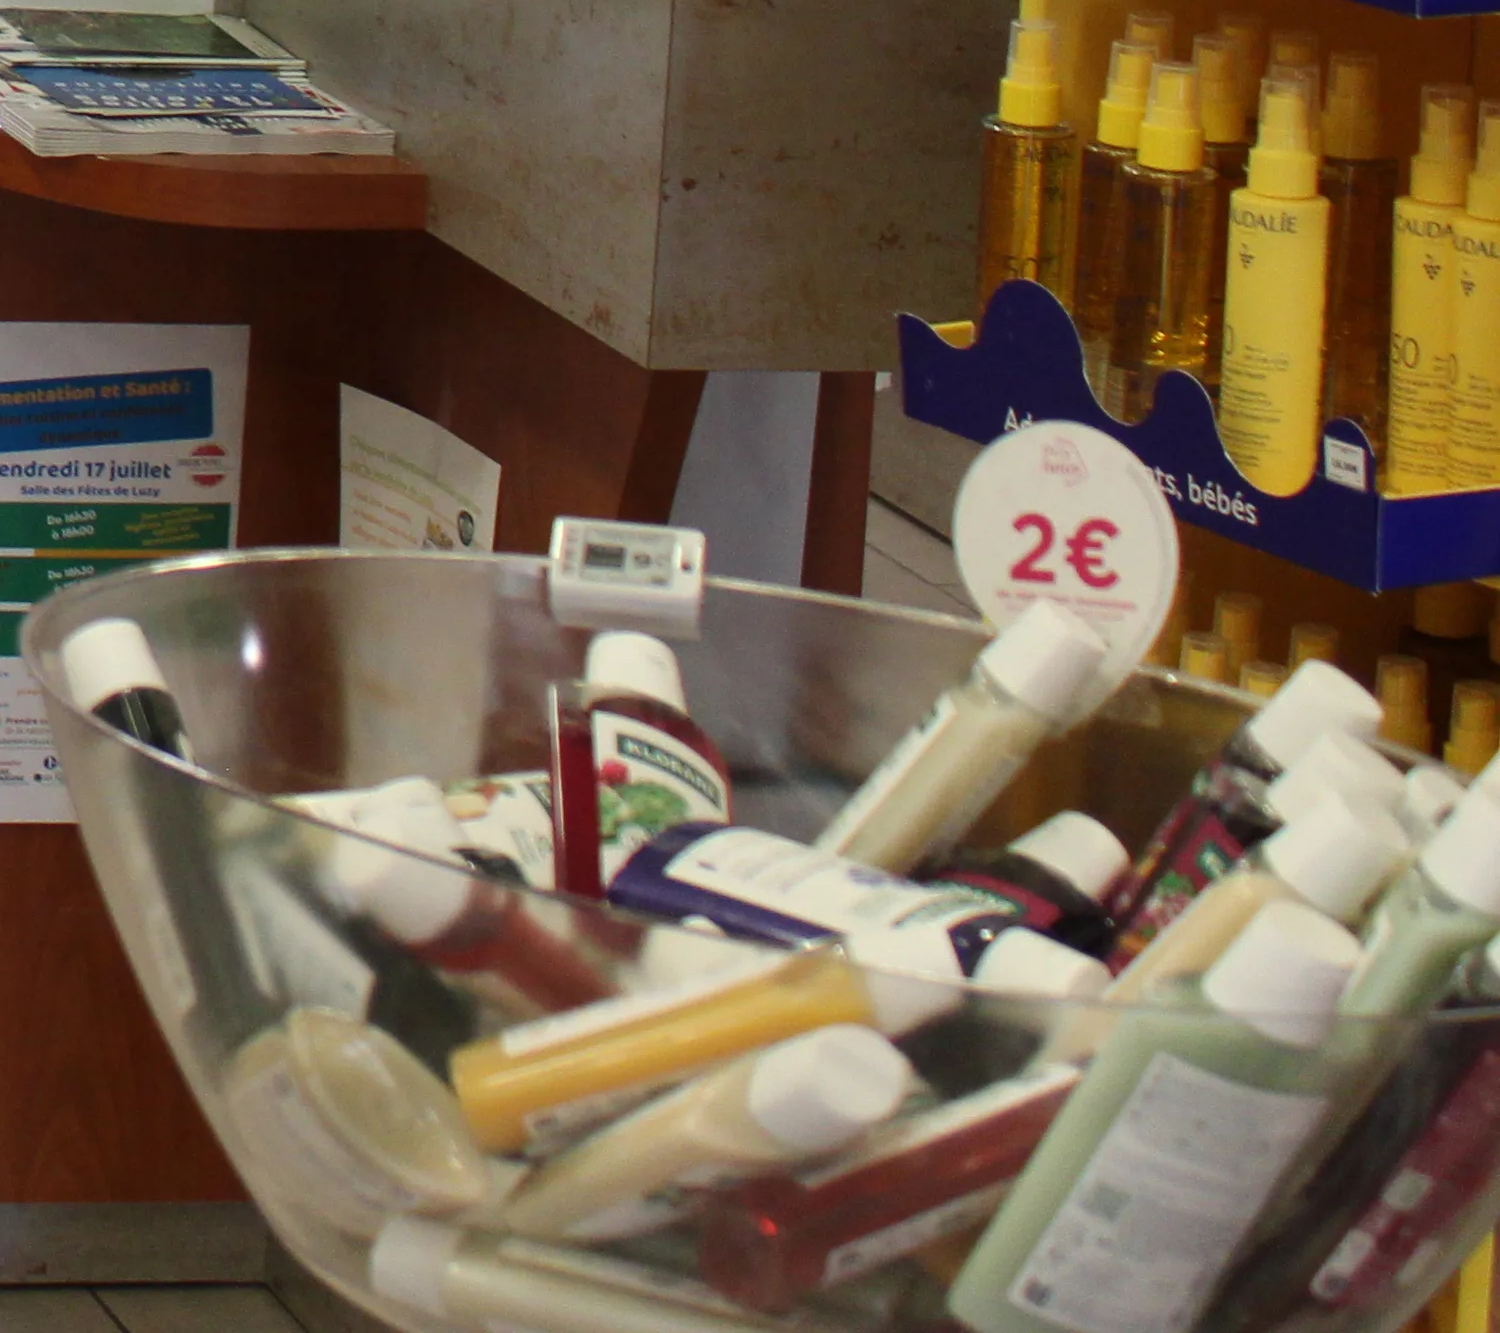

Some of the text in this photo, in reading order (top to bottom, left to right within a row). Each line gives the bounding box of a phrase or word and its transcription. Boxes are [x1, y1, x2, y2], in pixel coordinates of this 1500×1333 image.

[100, 383, 120, 399] et
[125, 379, 180, 397] Santé
[86, 462, 105, 478] 17
[109, 460, 171, 480] juillet
[1187, 475, 1259, 526] bébés
